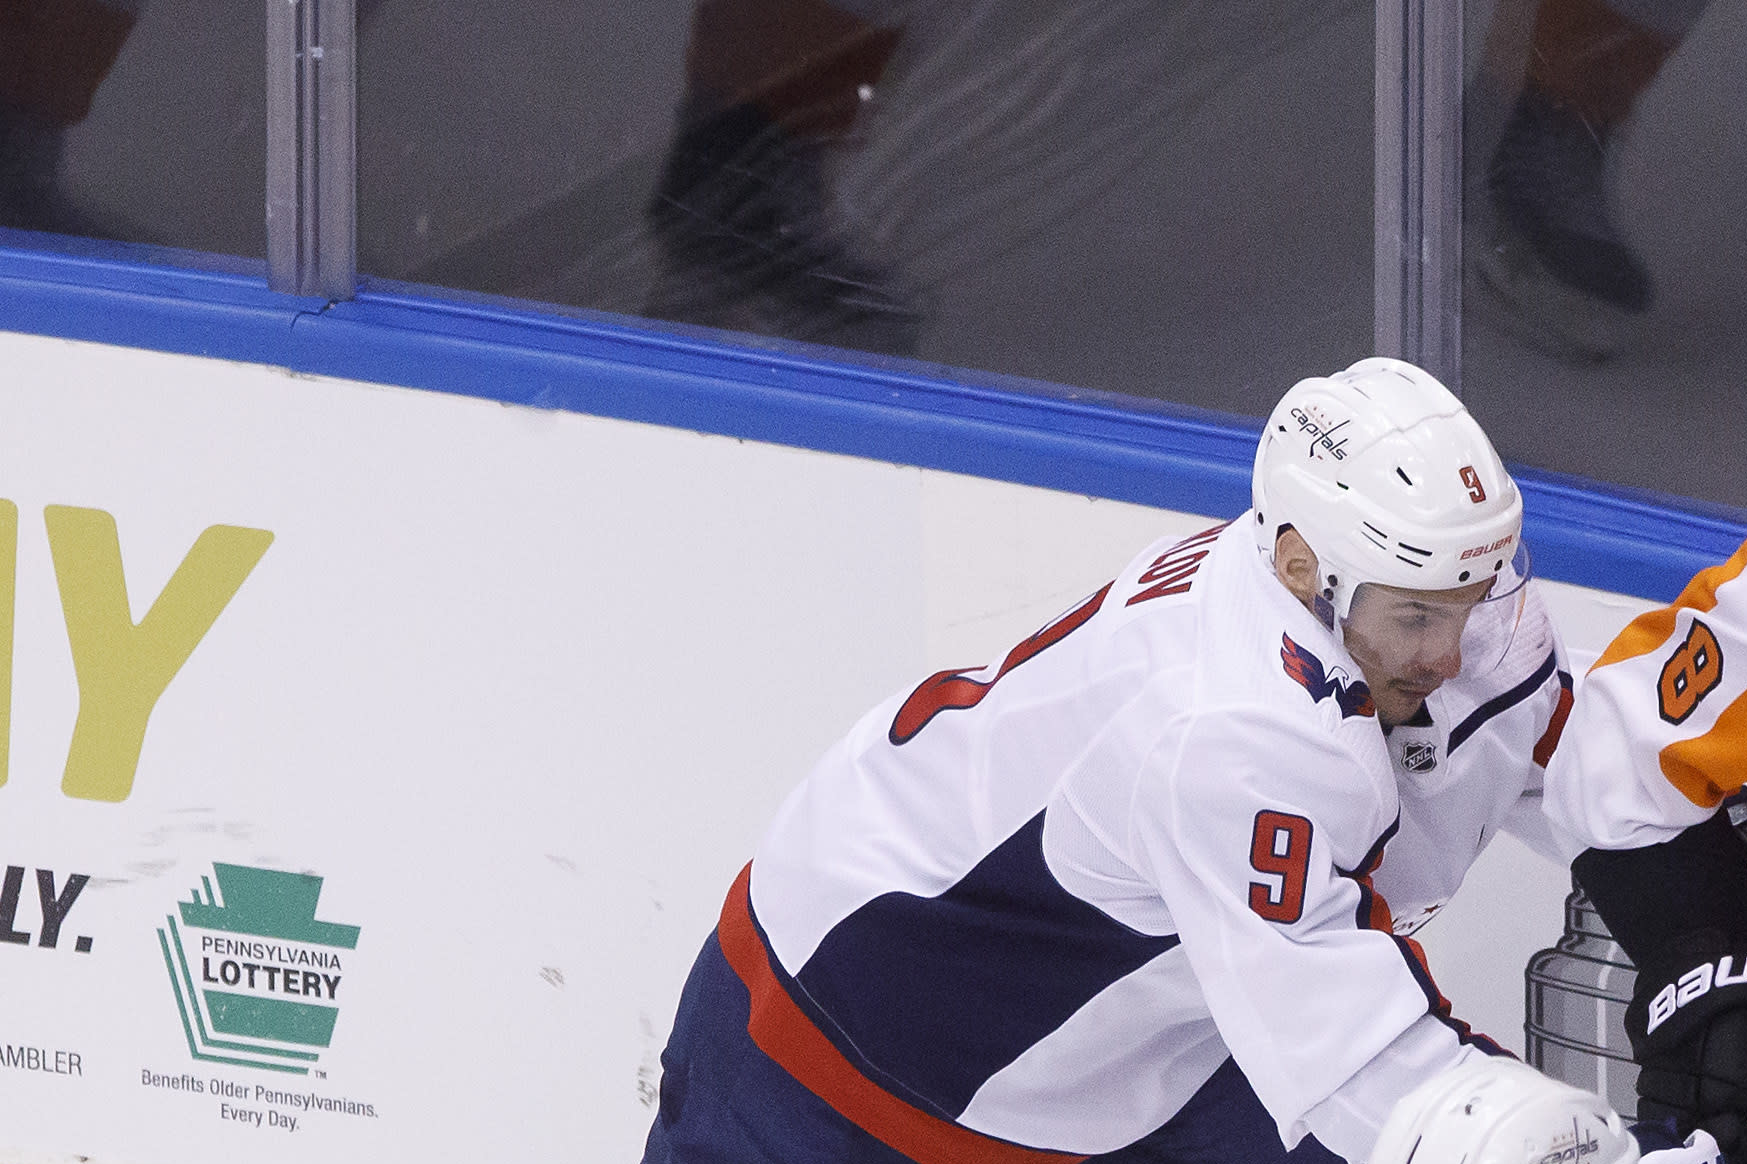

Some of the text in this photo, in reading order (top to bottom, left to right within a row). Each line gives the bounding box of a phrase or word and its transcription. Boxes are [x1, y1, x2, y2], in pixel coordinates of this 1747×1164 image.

[1459, 466, 1487, 504] 9
[1460, 535, 1513, 560] BAUER
[0, 498, 275, 803] Y
[1657, 617, 1724, 726] 8
[1249, 809, 1314, 924] 9
[201, 936, 342, 971] PENNSYLVANIA
[202, 956, 342, 1001] LOTTERY
[141, 1069, 379, 1118] Benefits Older Pennsylvanians.
[220, 1103, 300, 1132] Every Day.
